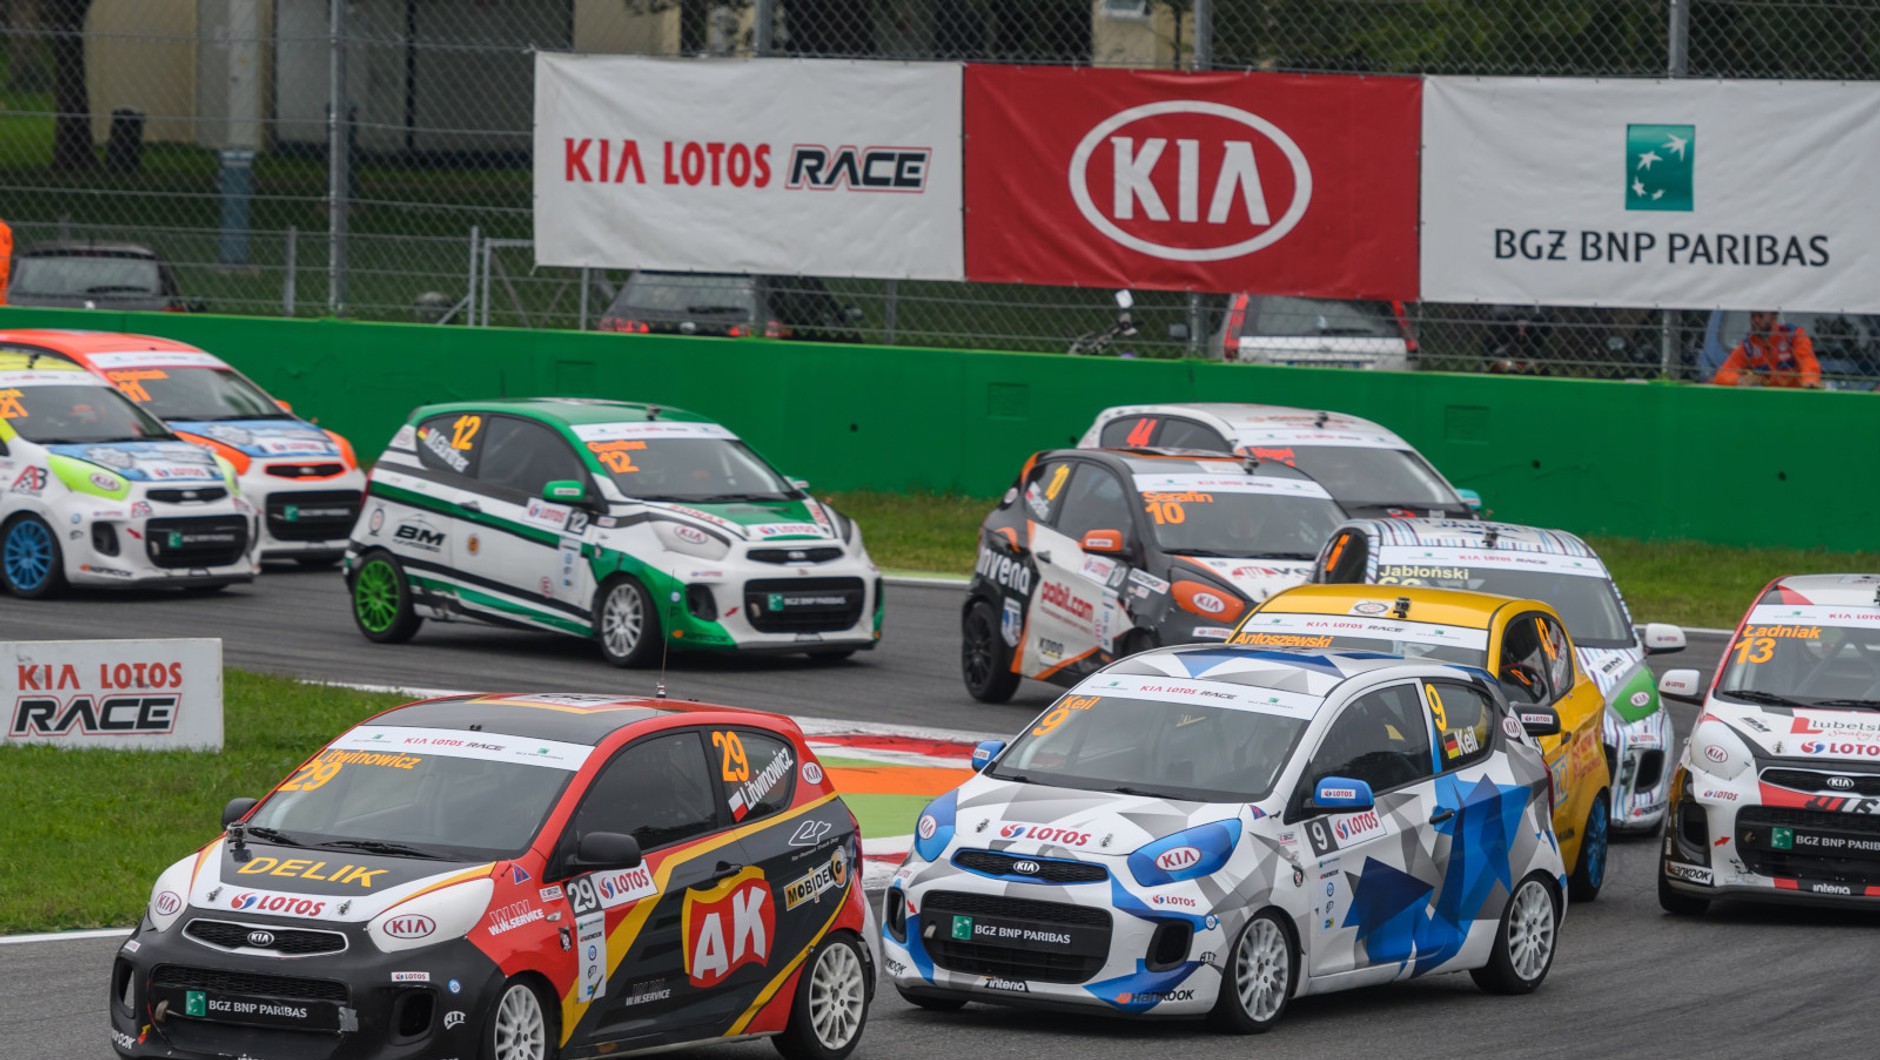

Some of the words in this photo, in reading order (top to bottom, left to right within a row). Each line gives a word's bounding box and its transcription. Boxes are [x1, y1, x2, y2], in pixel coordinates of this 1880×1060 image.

[564, 138, 646, 184] KIA
[663, 141, 771, 188] LOTOS
[788, 147, 929, 190] RACE
[1111, 136, 1271, 225] KIA
[1580, 231, 1655, 264] BNP
[1668, 233, 1830, 267] PARIBAS
[451, 415, 481, 450] 12
[598, 450, 640, 473] 12
[1141, 490, 1214, 504] Serafin
[570, 512, 589, 534] 12
[1145, 502, 1186, 525] 10
[394, 524, 447, 547] BM
[1380, 564, 1469, 580] Jabłoński
[1197, 594, 1220, 611] KIA
[1232, 631, 1334, 648] Antoszewski
[1742, 624, 1823, 639] Ładniak
[1733, 637, 1776, 665] 13
[17, 664, 81, 691] KIA
[100, 662, 183, 690] LOTOS
[1057, 694, 1101, 711] Keil
[1166, 687, 1197, 695] LOTOS
[1199, 690, 1238, 700] RACE
[12, 695, 179, 734] RACE
[1425, 683, 1447, 731] 9
[1032, 708, 1070, 736] 9
[431, 738, 465, 747] LOTOS
[465, 742, 506, 751] RACE
[1454, 726, 1480, 756] Keil
[712, 731, 749, 782] 29
[1706, 747, 1726, 762] KIA
[276, 759, 343, 792] 29
[739, 747, 794, 810] Litwinowicz
[806, 766, 820, 780] KIA
[1831, 778, 1850, 787] KIA
[1713, 790, 1739, 801] LOTOS
[920, 816, 933, 839] KIA
[1347, 810, 1379, 835] LOTOS
[1025, 826, 1092, 847] LOTOS
[1312, 821, 1328, 850] 9
[1796, 835, 1819, 846] BGZ
[1821, 837, 1845, 848] BNP
[1015, 862, 1036, 872] KIA
[1162, 850, 1196, 868] KIA
[236, 856, 390, 888] DELIK
[613, 869, 650, 895] LOTOS
[157, 895, 175, 911] KIA
[257, 895, 326, 917] LOTOS
[567, 878, 597, 914] 29
[1166, 895, 1196, 907] LOTOS
[392, 919, 427, 933] KIA
[692, 886, 767, 980] AK
[974, 924, 996, 936] BGZ
[998, 927, 1022, 938] BNP
[1023, 930, 1071, 944] PARIBAS
[251, 932, 269, 943] KIA
[208, 1000, 231, 1011] BGZ
[233, 1002, 257, 1013] BNP
[259, 1004, 307, 1018] PARIBAS
